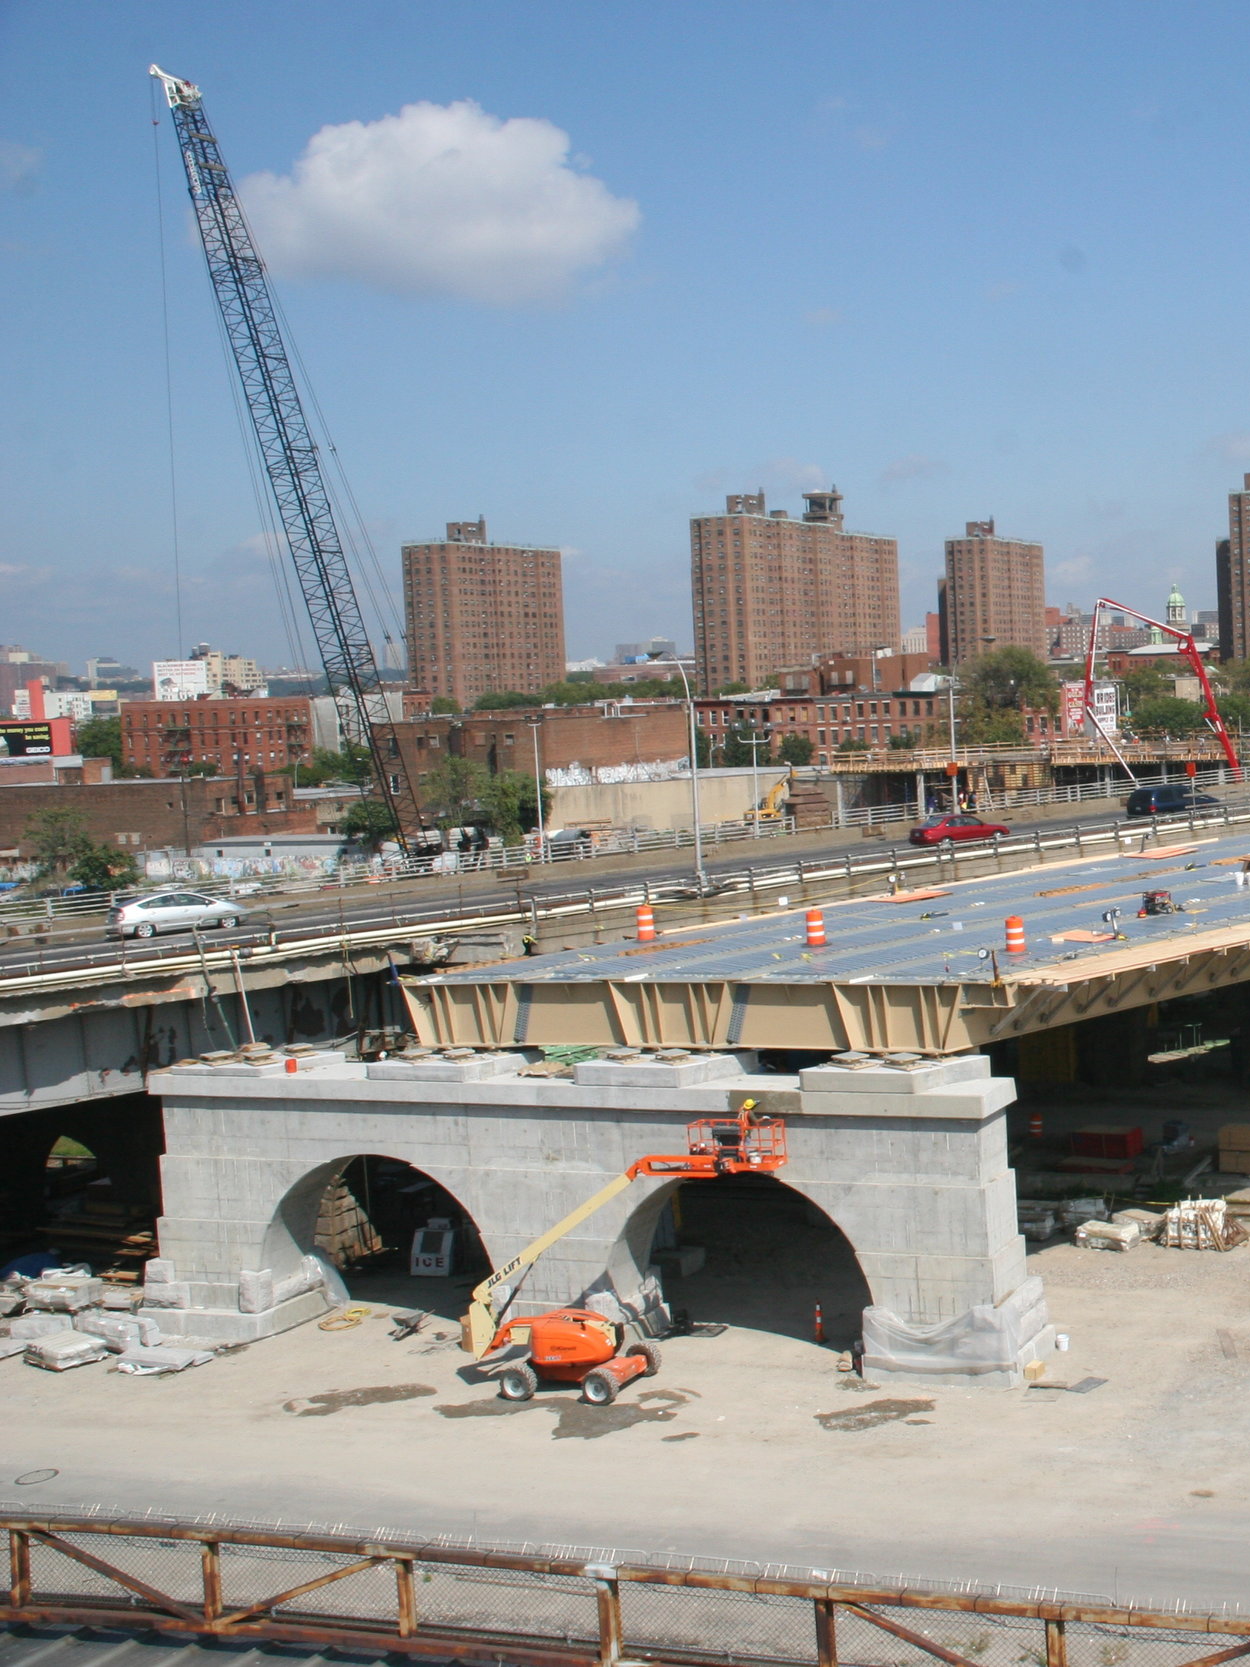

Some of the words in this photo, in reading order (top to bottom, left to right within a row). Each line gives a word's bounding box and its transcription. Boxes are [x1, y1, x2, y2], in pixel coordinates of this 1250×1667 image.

[415, 1256, 445, 1268] ICE
[487, 1272, 502, 1289] JLG
[503, 1256, 521, 1275] LIFT
